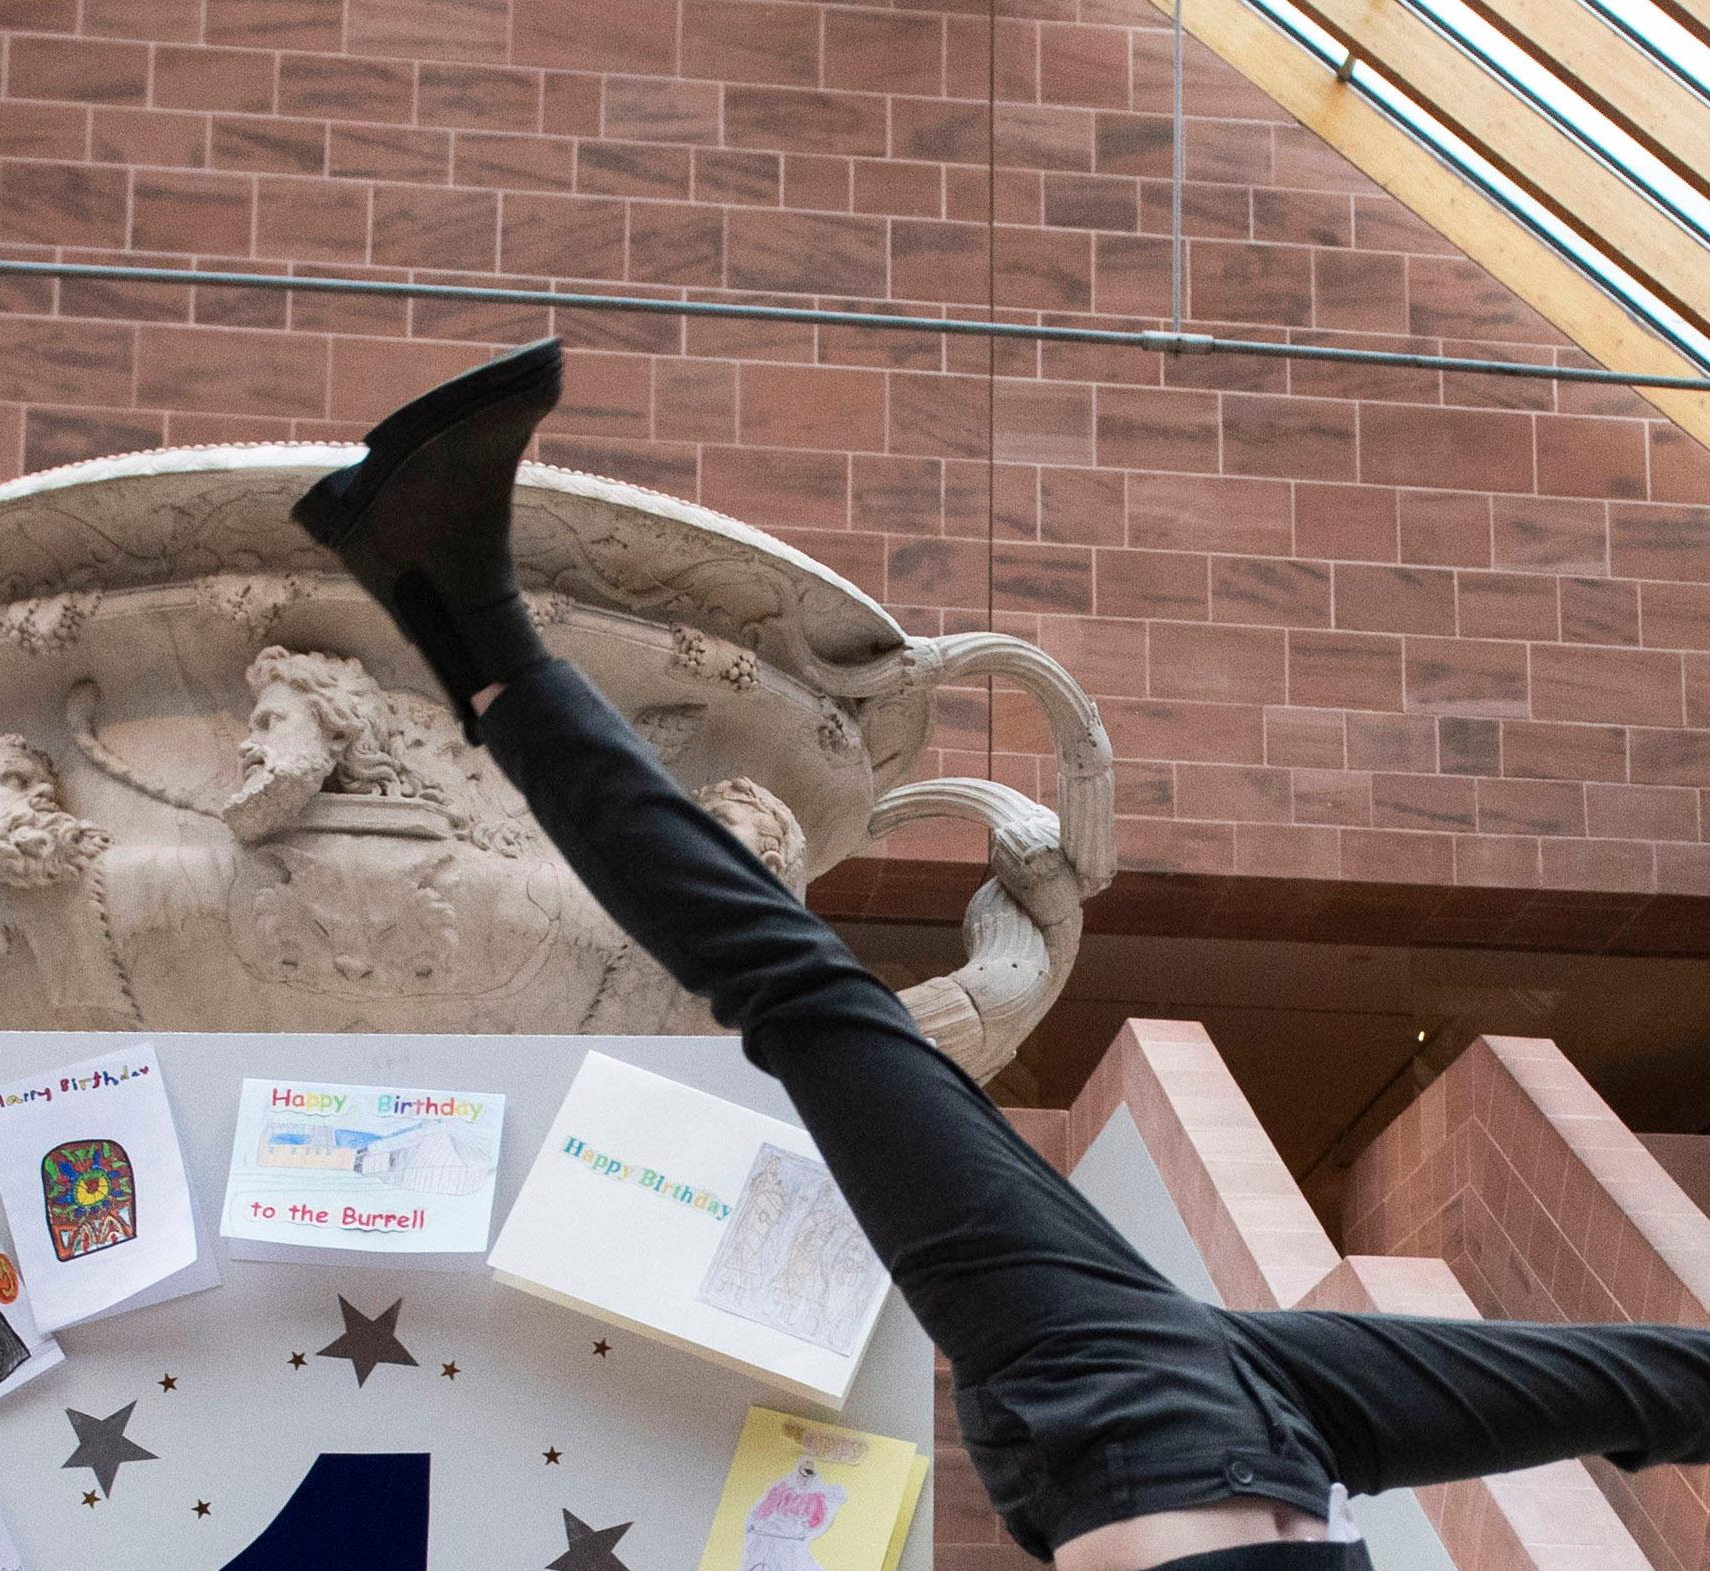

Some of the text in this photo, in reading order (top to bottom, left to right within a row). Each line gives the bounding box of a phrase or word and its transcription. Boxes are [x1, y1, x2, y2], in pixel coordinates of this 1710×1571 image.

[59, 1065, 149, 1093] Birthday
[272, 1088, 483, 1121] Happy Birthday
[562, 1136, 731, 1221] Happy Birthday
[251, 1202, 425, 1230] to the Burrell
